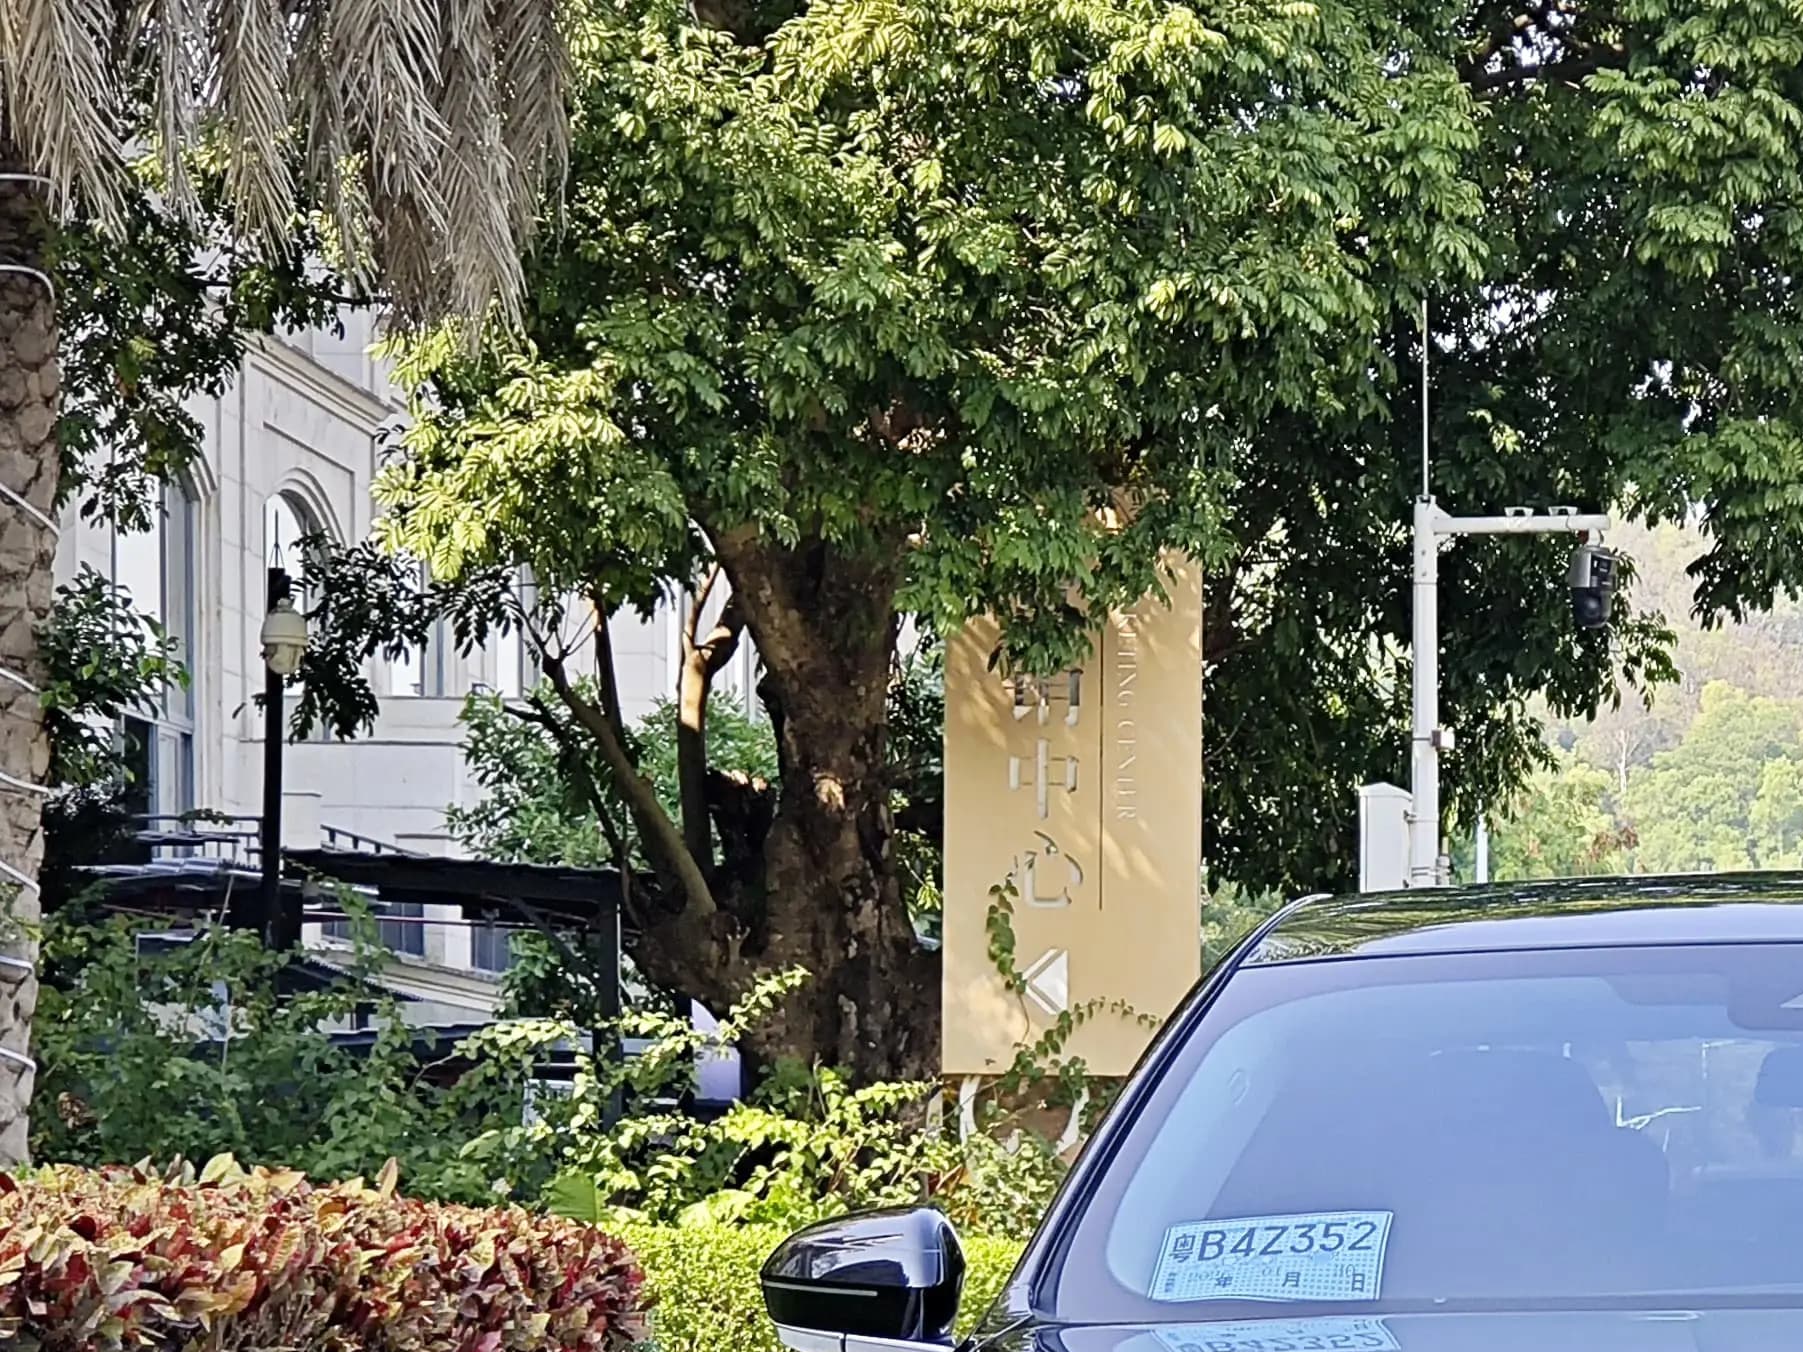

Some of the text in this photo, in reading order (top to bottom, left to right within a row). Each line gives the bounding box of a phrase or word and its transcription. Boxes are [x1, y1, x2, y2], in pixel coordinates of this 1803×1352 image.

[1117, 612, 1137, 819] KETING CENTER
[1168, 1220, 1378, 1263] 粤B4Z352
